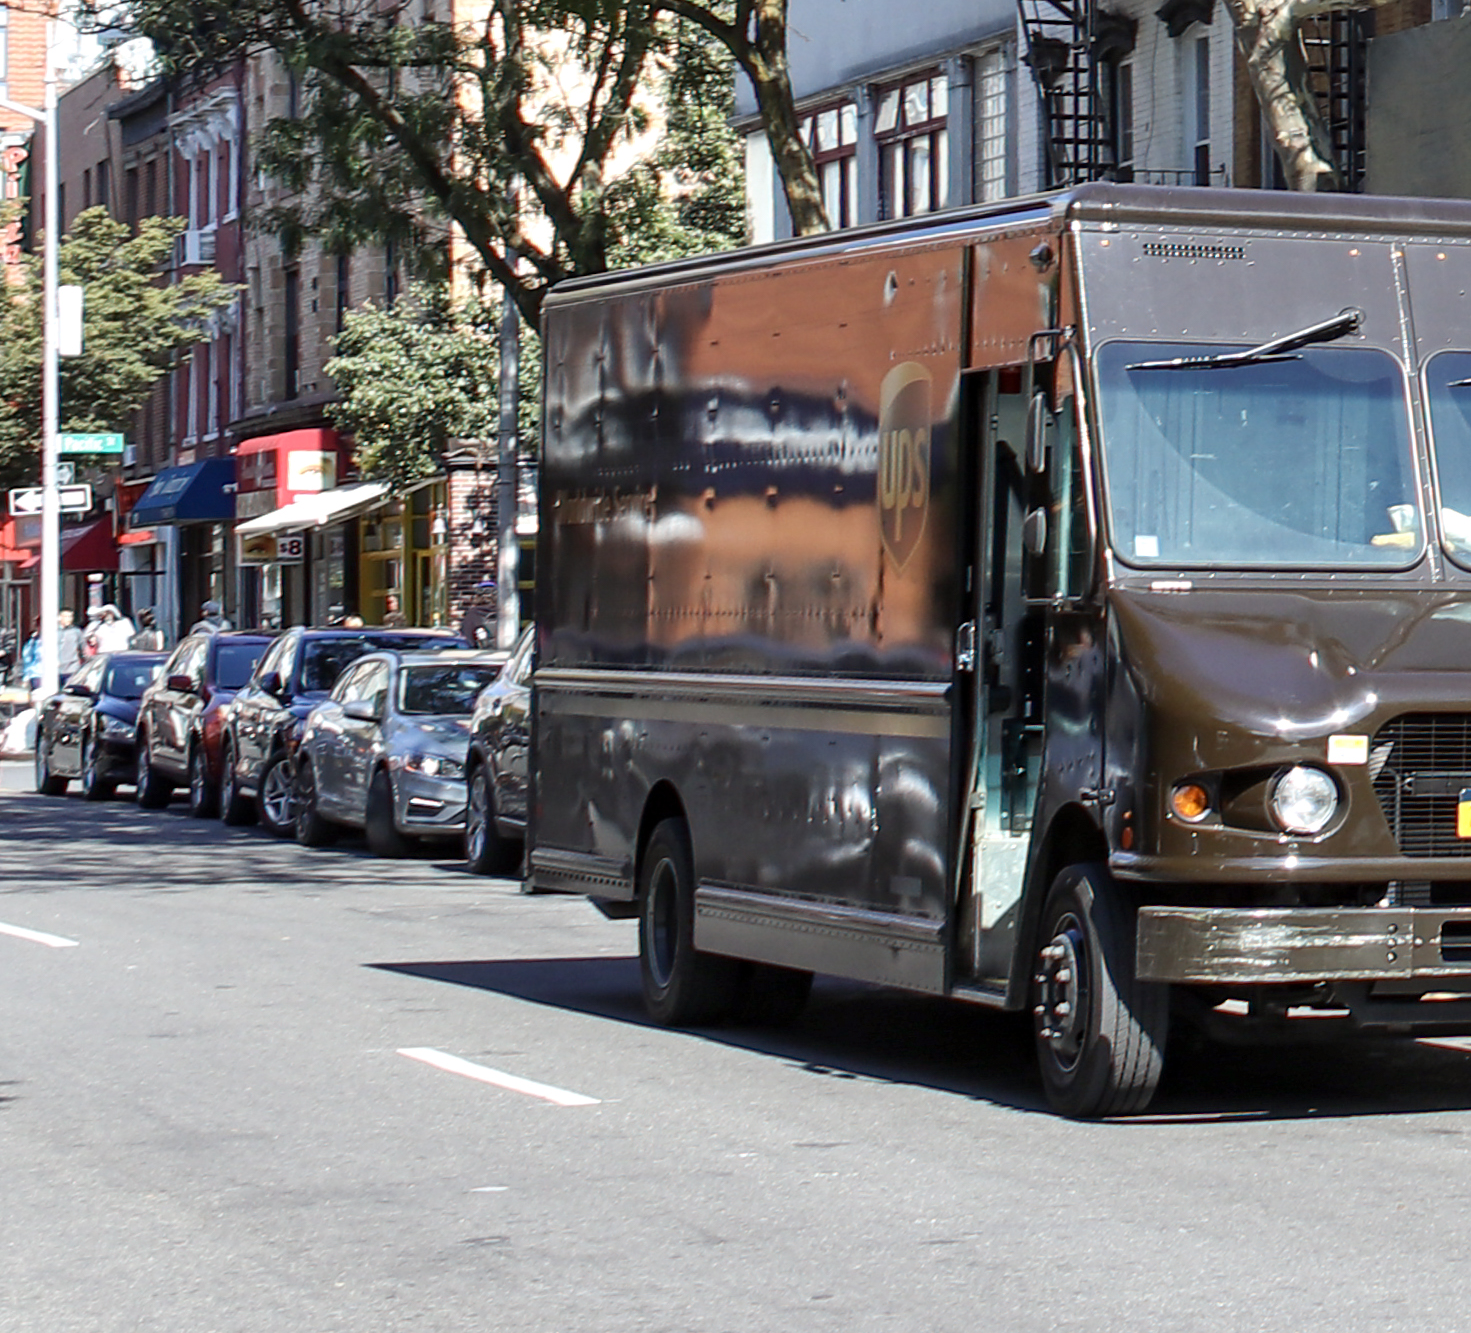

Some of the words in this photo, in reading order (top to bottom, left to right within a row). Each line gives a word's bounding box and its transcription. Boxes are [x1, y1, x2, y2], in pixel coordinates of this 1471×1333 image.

[64, 436, 104, 452] Pacific
[106, 436, 117, 446] St
[881, 427, 928, 542] ups
